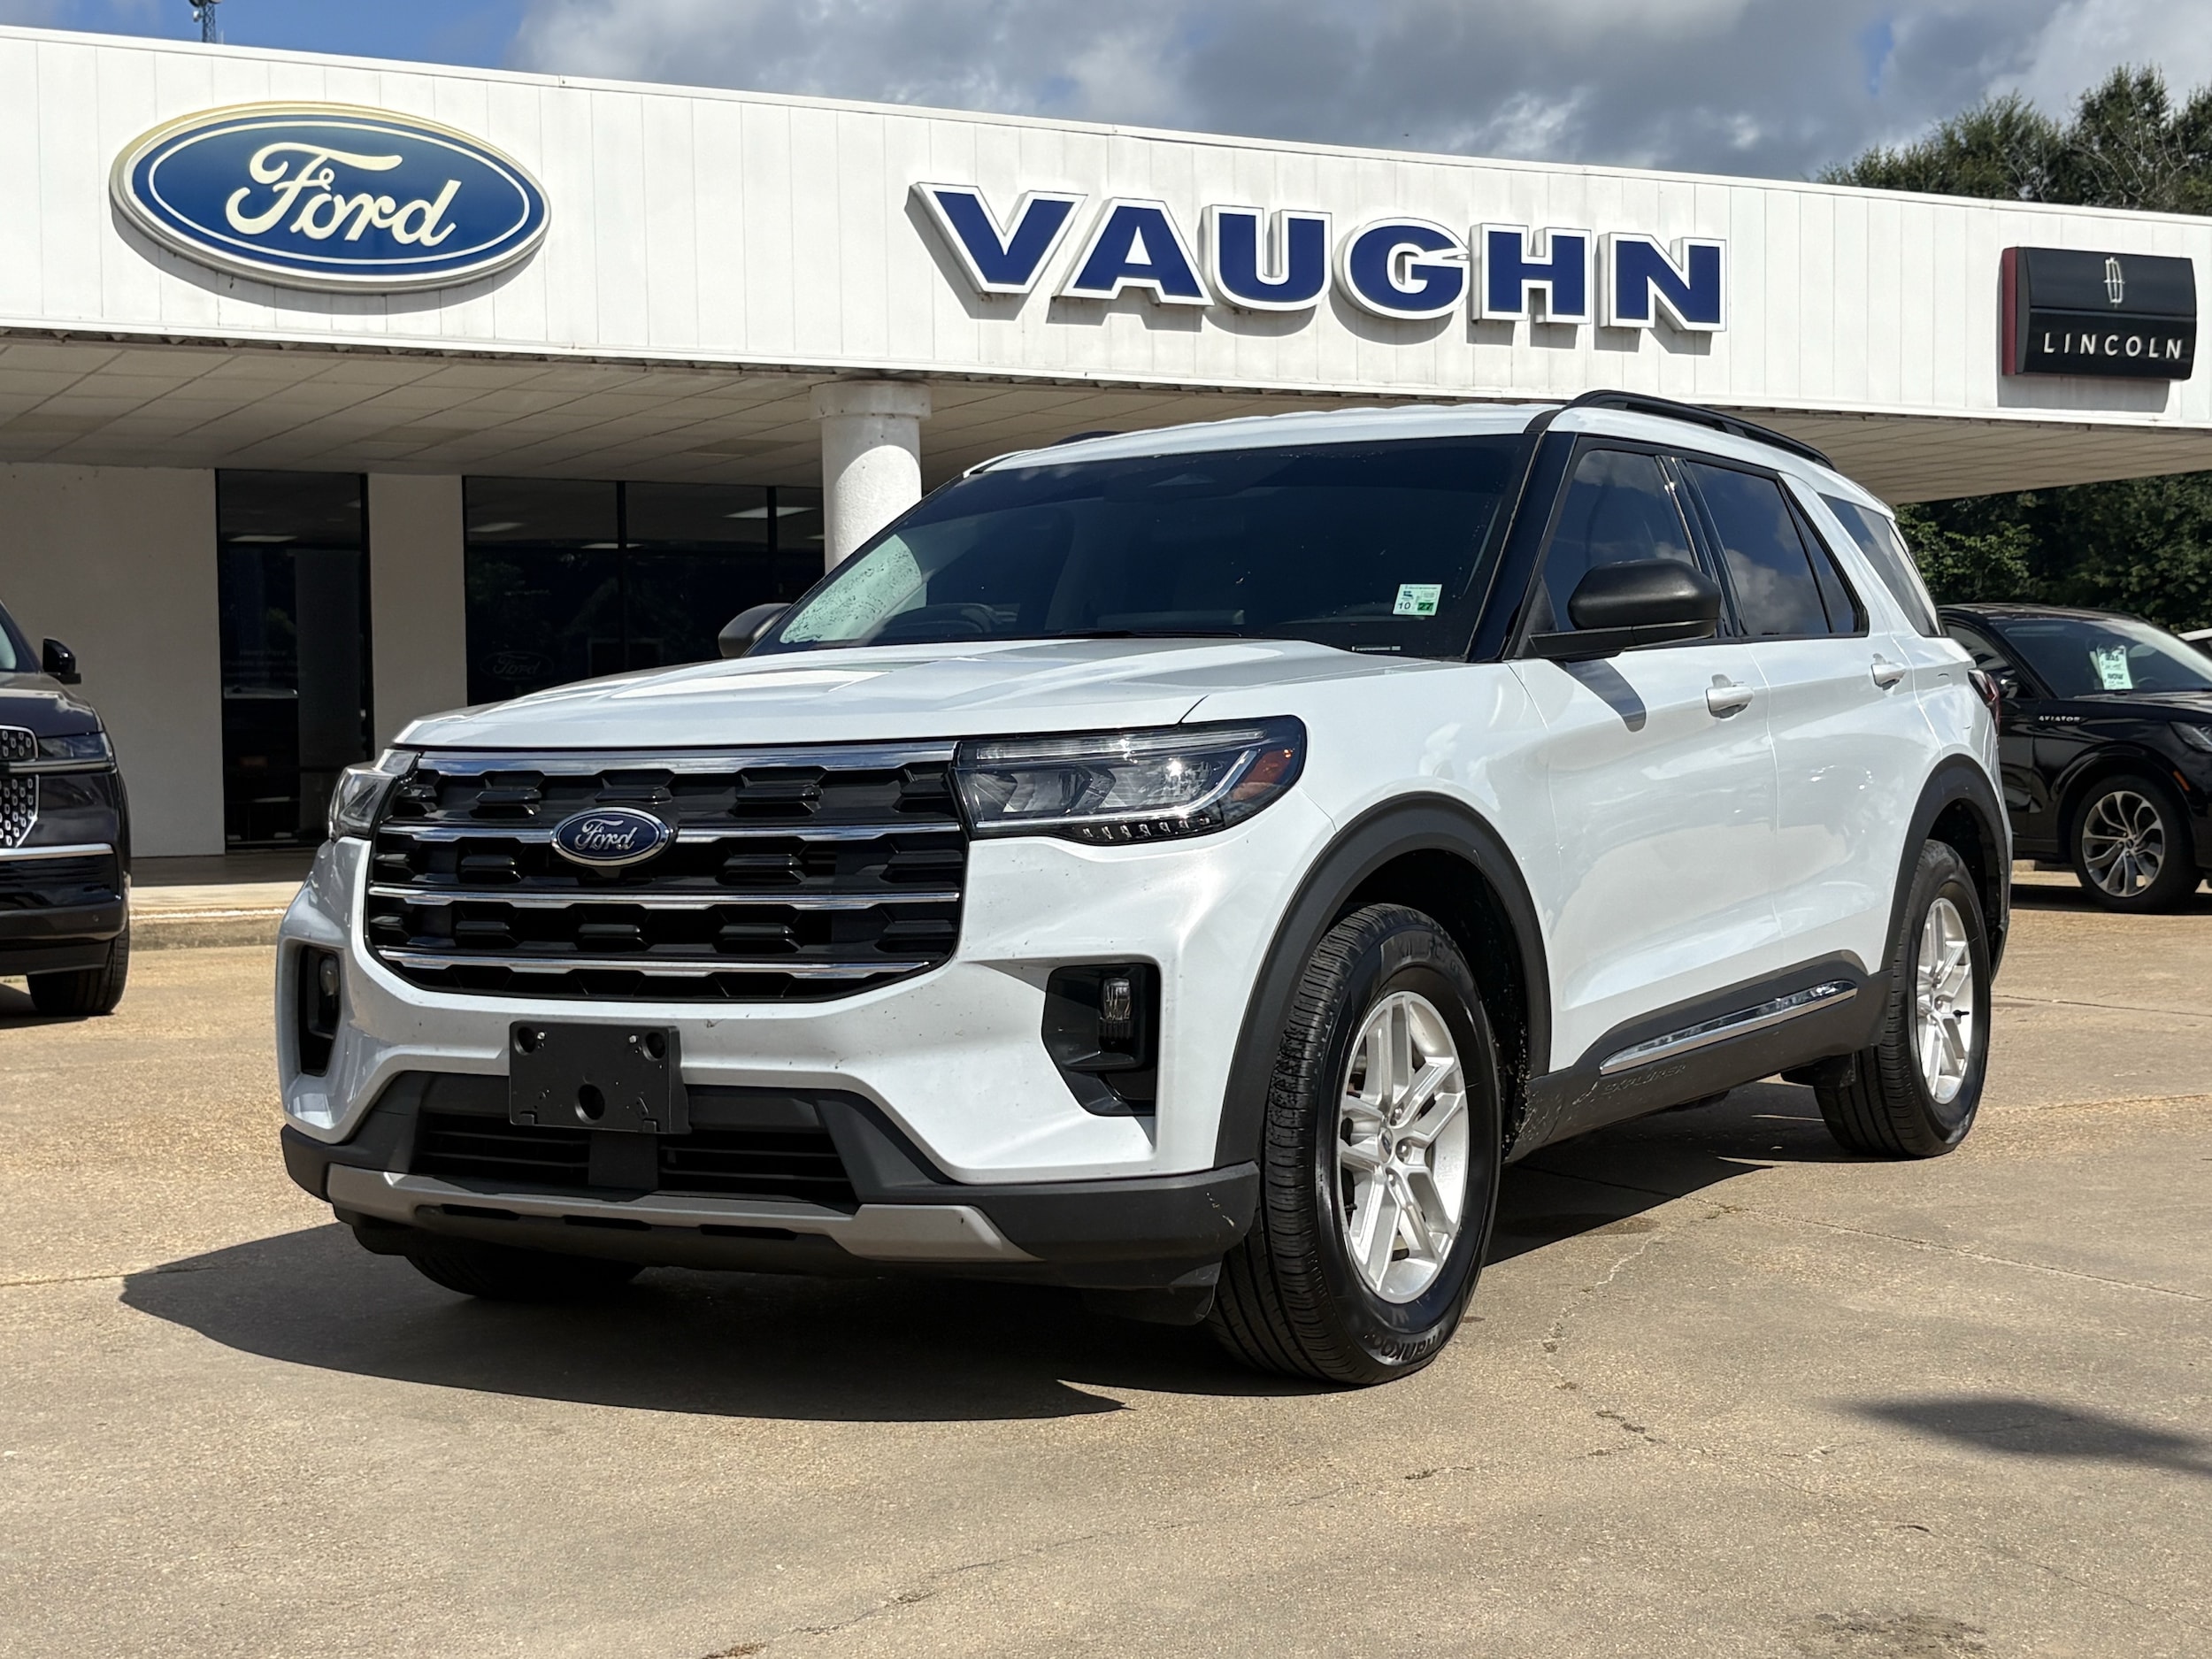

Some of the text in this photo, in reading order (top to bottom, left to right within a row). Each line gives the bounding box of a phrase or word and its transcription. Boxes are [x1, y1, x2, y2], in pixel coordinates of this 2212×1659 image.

[227, 142, 457, 247] Ford
[911, 181, 1727, 333] VAUGHN
[2043, 332, 2182, 359] LINCOLN
[1417, 603, 1434, 611] 27
[493, 654, 541, 674] Ford
[575, 818, 638, 850] Ford
